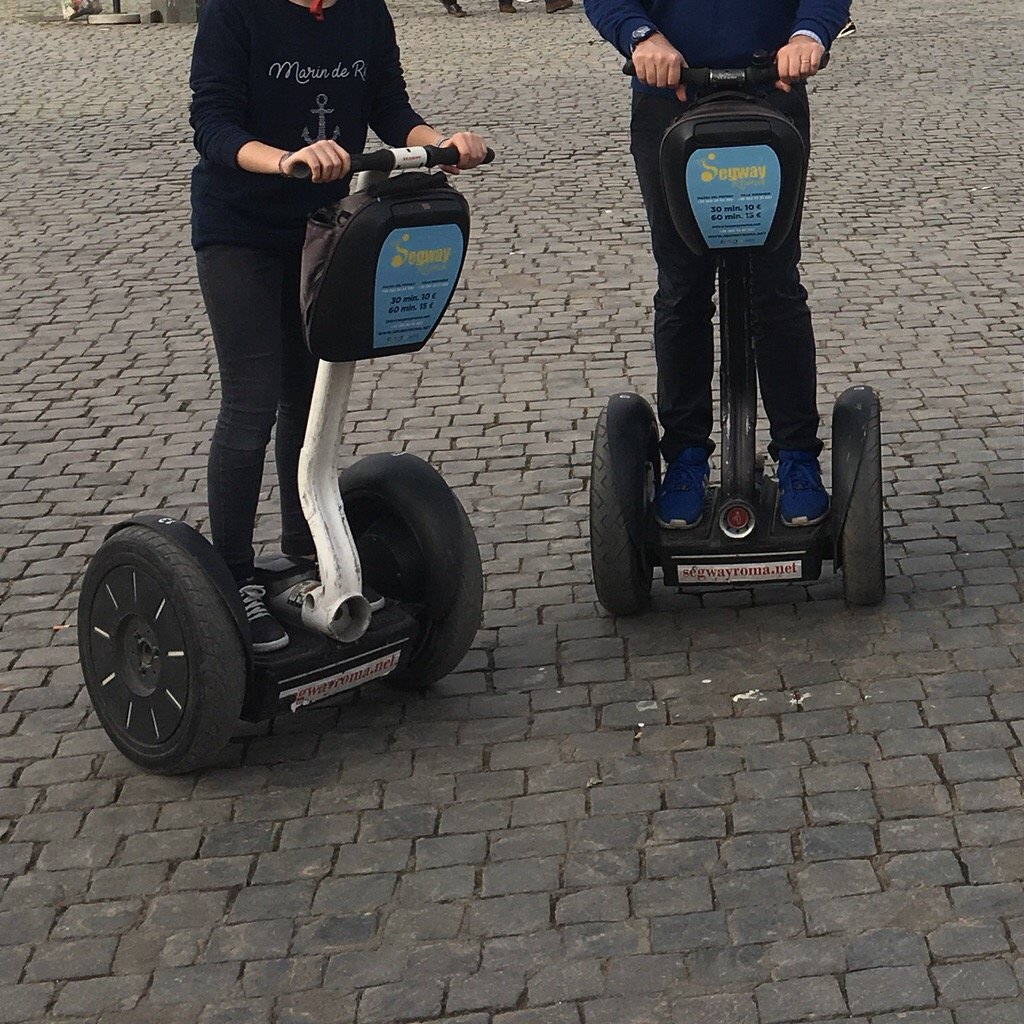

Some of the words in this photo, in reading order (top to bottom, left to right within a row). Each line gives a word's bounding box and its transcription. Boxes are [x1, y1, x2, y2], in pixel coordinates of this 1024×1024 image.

[268, 61, 330, 84] Marin
[331, 62, 351, 78] de
[700, 153, 766, 182] Segway
[388, 305, 400, 314] 60
[419, 302, 428, 310] 15
[391, 296, 401, 305] 30
[421, 292, 431, 301] 10
[683, 562, 797, 581] segwayroma.net
